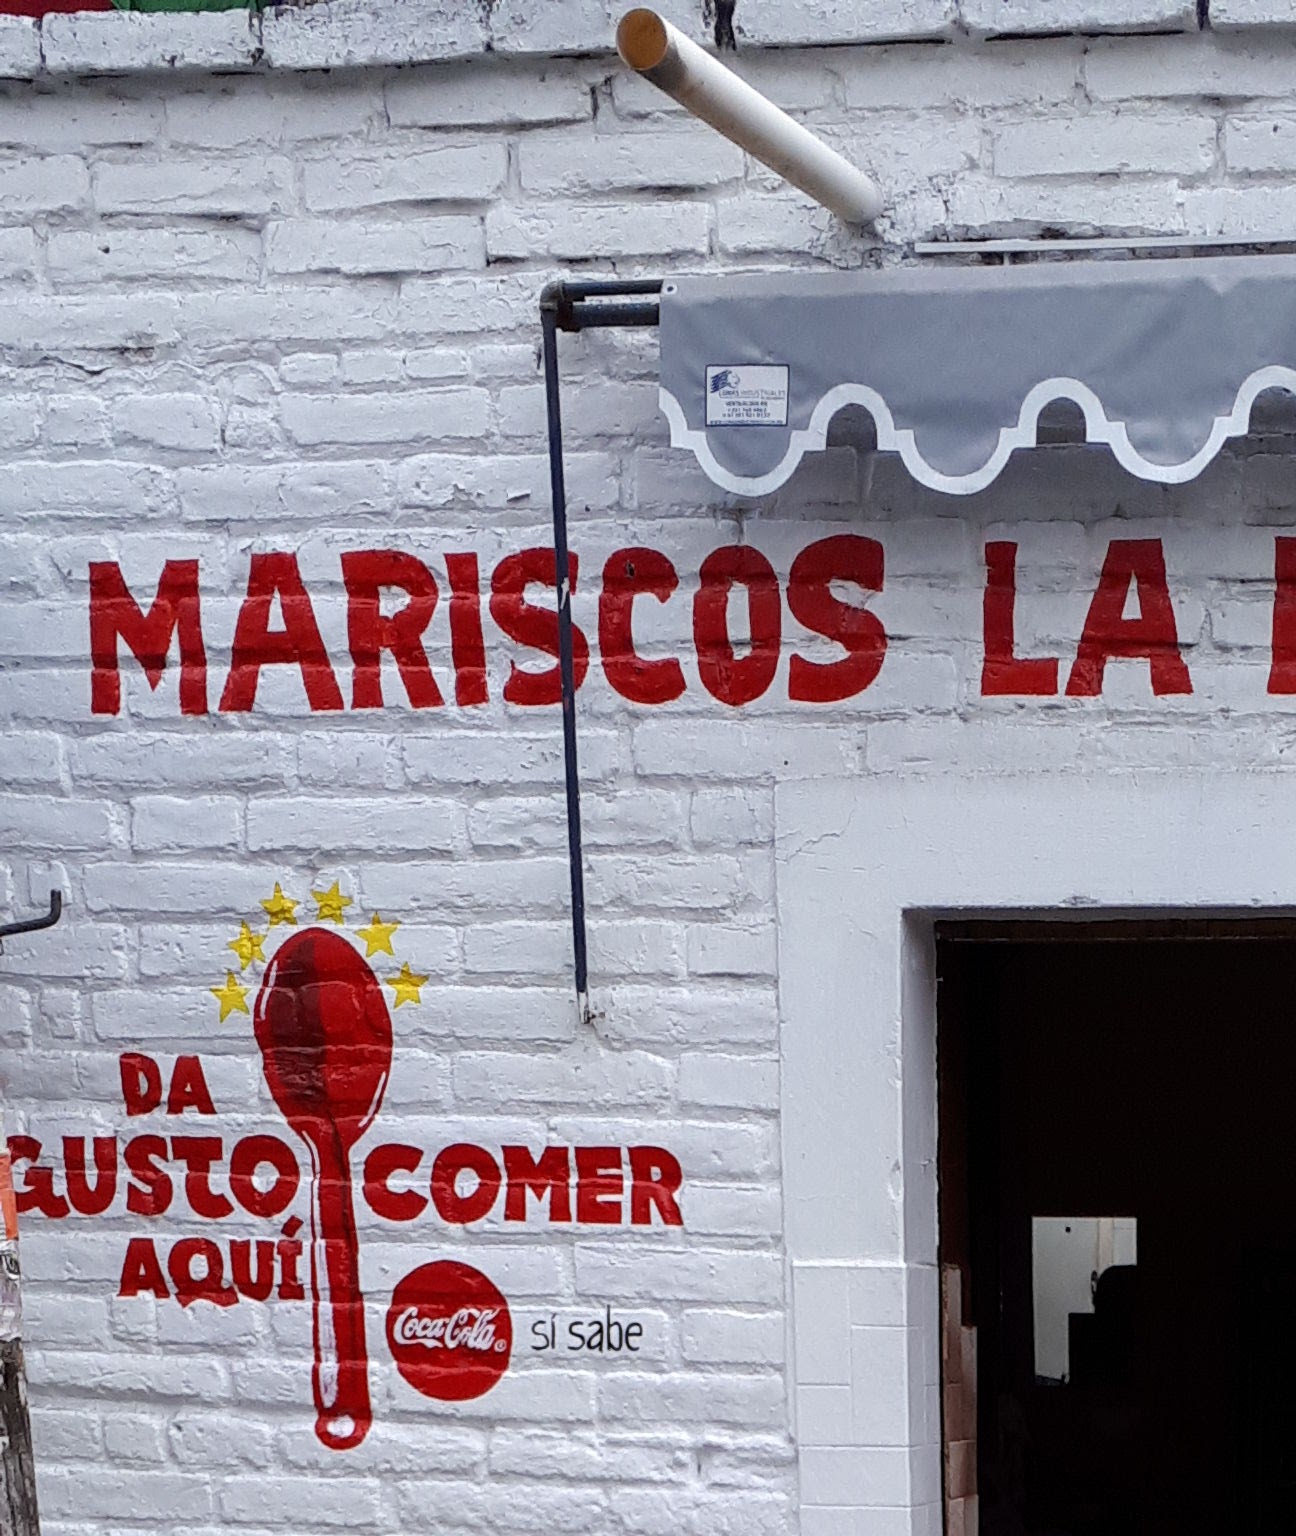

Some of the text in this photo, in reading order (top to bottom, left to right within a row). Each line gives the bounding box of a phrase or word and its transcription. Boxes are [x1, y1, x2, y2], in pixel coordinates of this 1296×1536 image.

[88, 535, 887, 716] MARISCOS
[981, 538, 1194, 697] LA
[119, 1052, 216, 1116] DA
[7, 1135, 684, 1226] GUSTO COMER
[118, 1216, 305, 1308] AQUÍ
[531, 1305, 643, 1353] sí sabe
